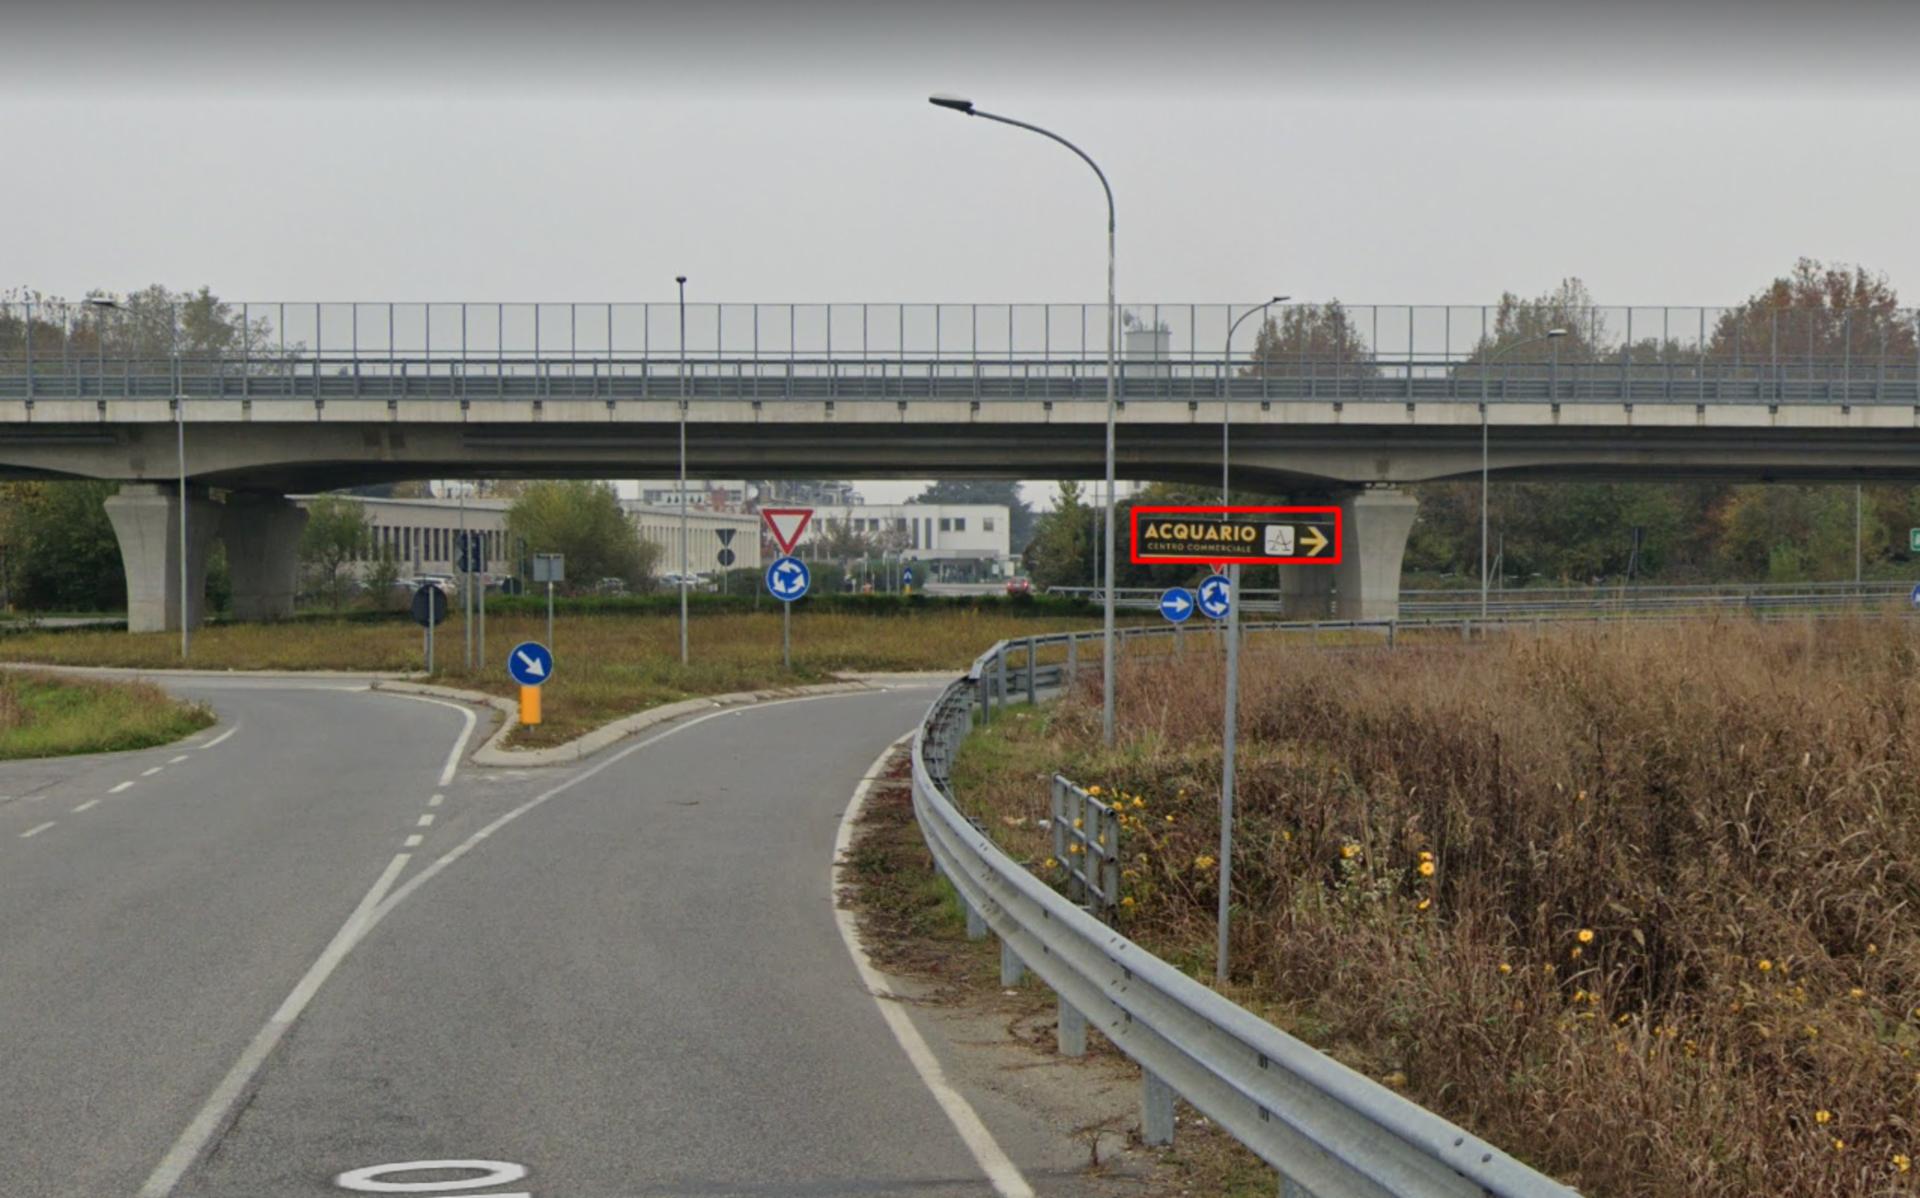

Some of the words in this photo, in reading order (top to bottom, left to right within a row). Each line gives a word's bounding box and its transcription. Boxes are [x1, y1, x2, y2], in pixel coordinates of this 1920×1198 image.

[1145, 523, 1256, 541] ACQUARIO
[1147, 542, 1184, 551] CENTRO
[1187, 543, 1251, 553] COMMERCIALE
